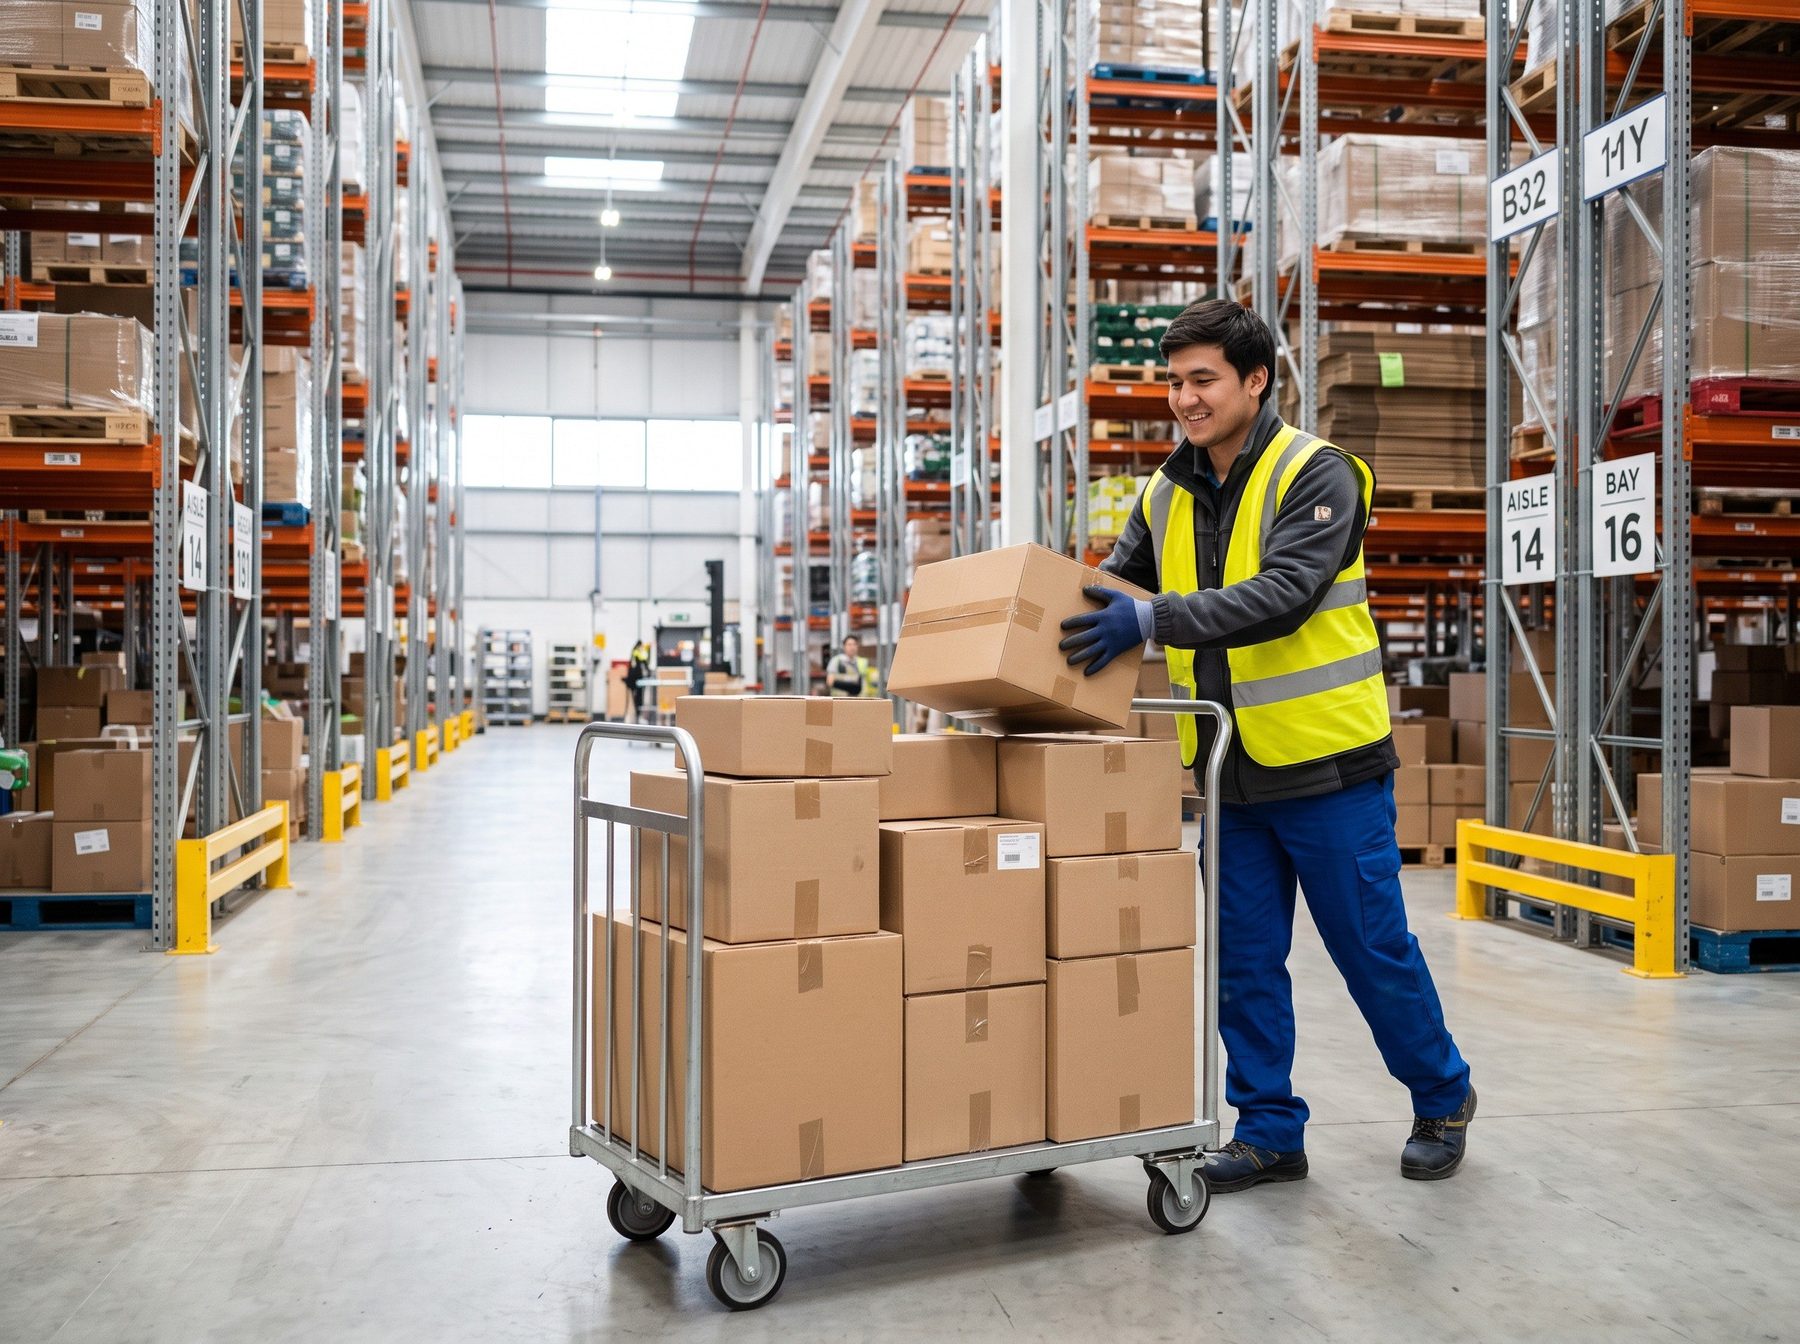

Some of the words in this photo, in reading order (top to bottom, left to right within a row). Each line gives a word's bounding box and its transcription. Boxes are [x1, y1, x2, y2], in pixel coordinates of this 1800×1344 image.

[1503, 170, 1546, 223] B32
[1507, 486, 1548, 512] AISLE
[1606, 467, 1640, 495] BAY
[190, 534, 202, 578] 14
[1511, 527, 1544, 573] 14
[1605, 512, 1642, 562] 16
